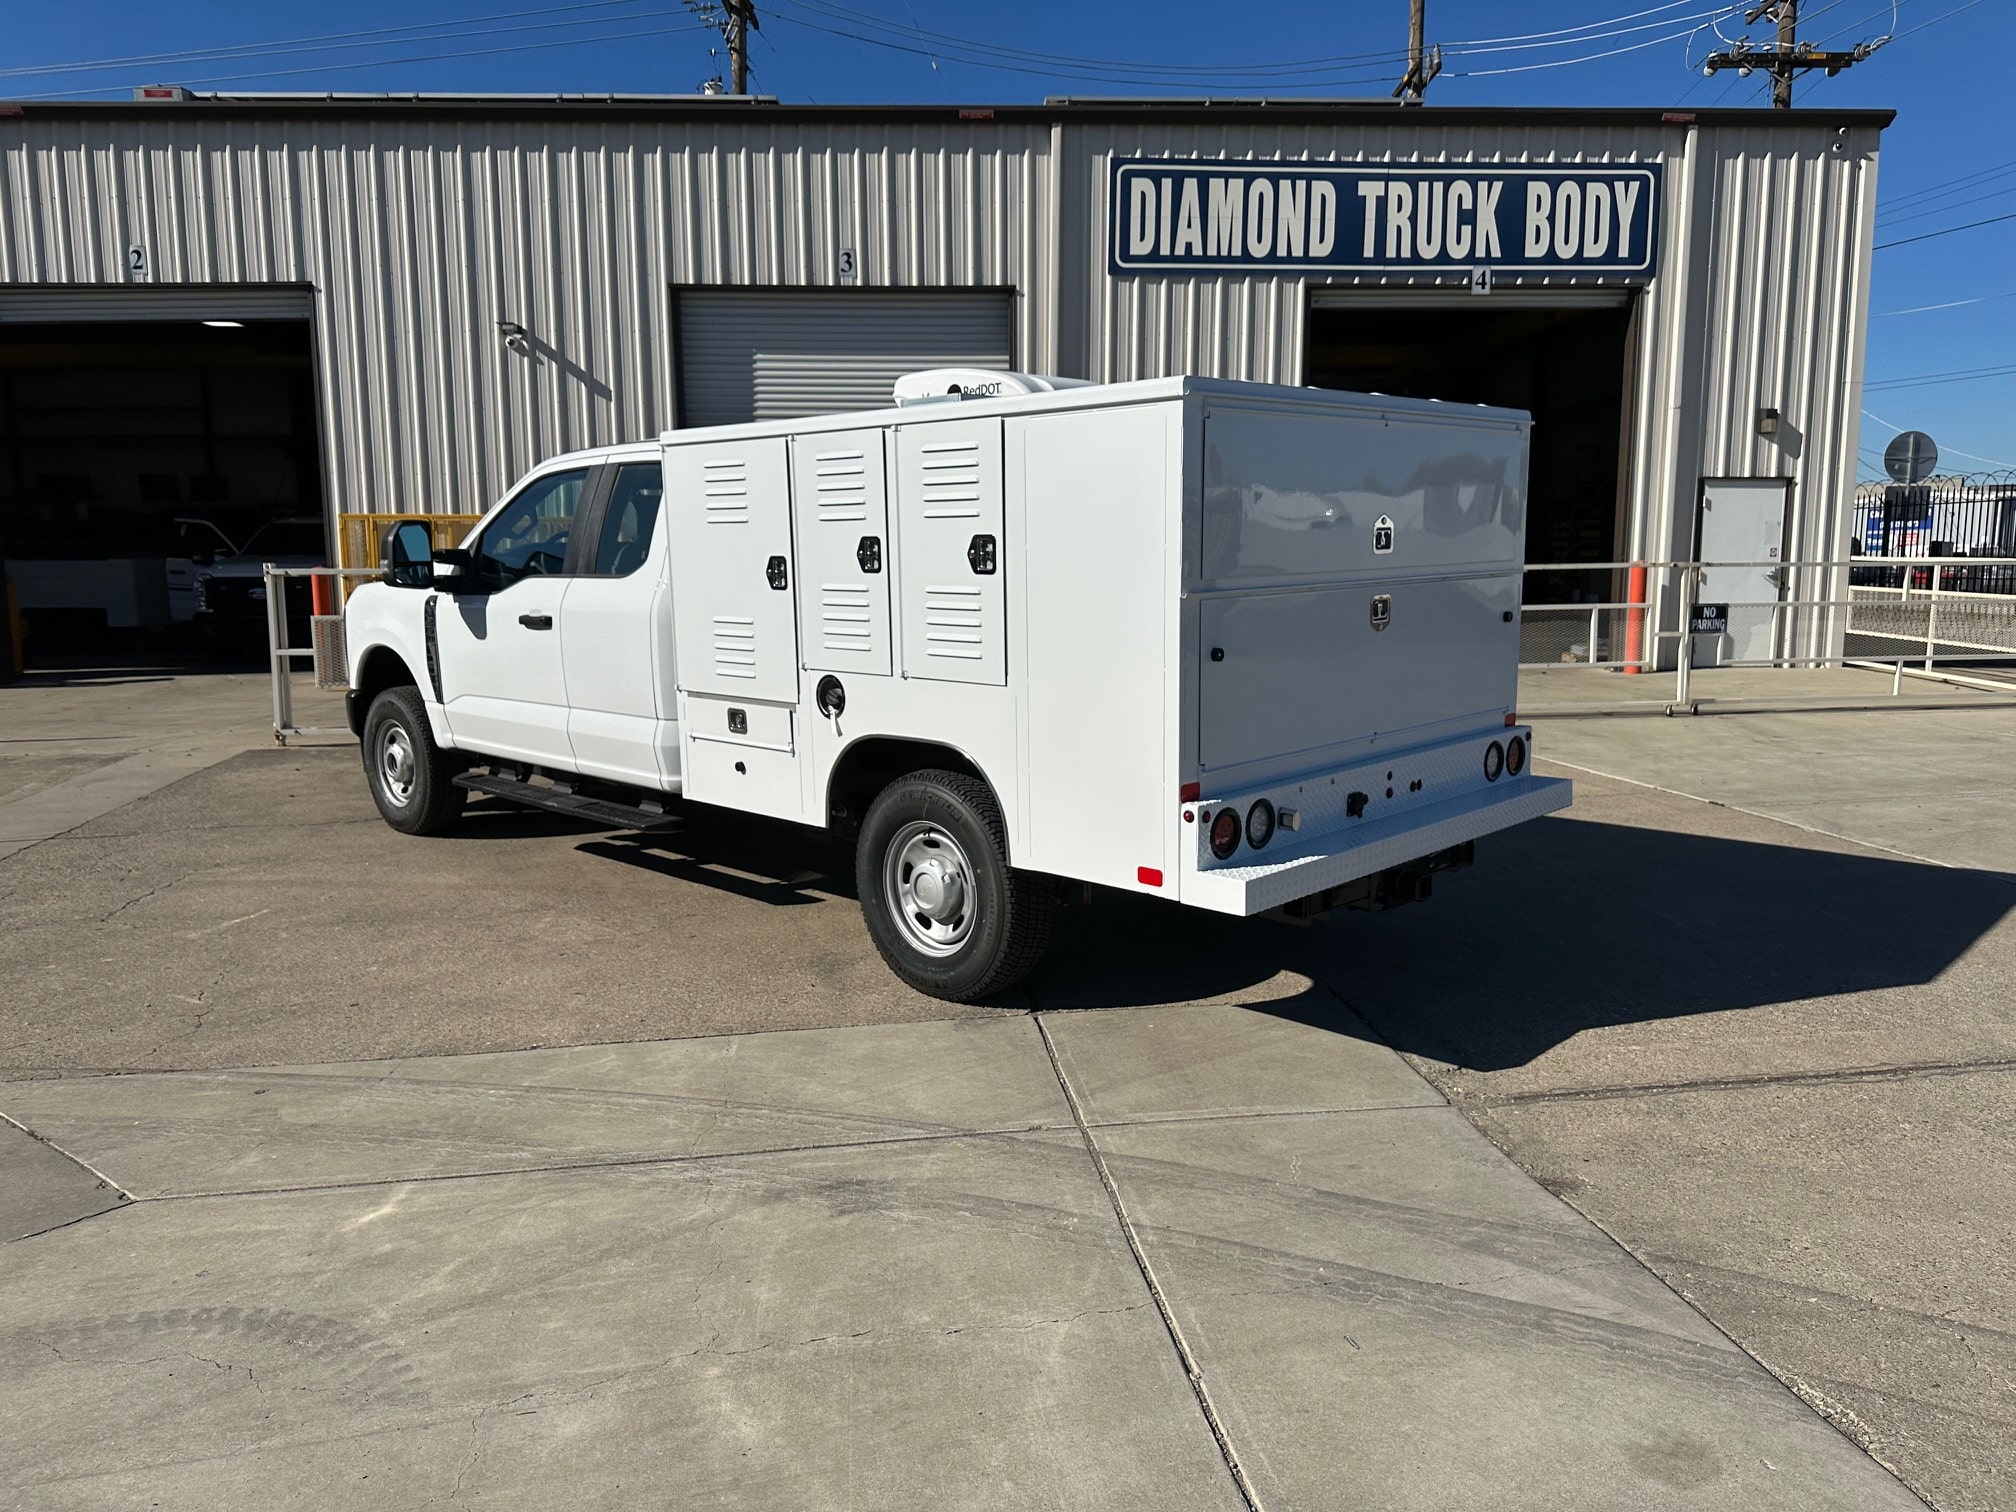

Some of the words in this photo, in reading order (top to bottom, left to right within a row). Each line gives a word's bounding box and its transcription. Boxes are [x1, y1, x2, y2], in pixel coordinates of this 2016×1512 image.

[1129, 177, 1337, 258] DIAMOND
[1357, 179, 1504, 260] TRUCK
[1524, 180, 1641, 260] BODY
[130, 249, 144, 270] 2
[840, 252, 853, 273] 3
[1474, 269, 1488, 290] 4
[963, 382, 1002, 396] RedDOT
[1703, 606, 1717, 618] NO
[1692, 618, 1726, 630] PARKING
